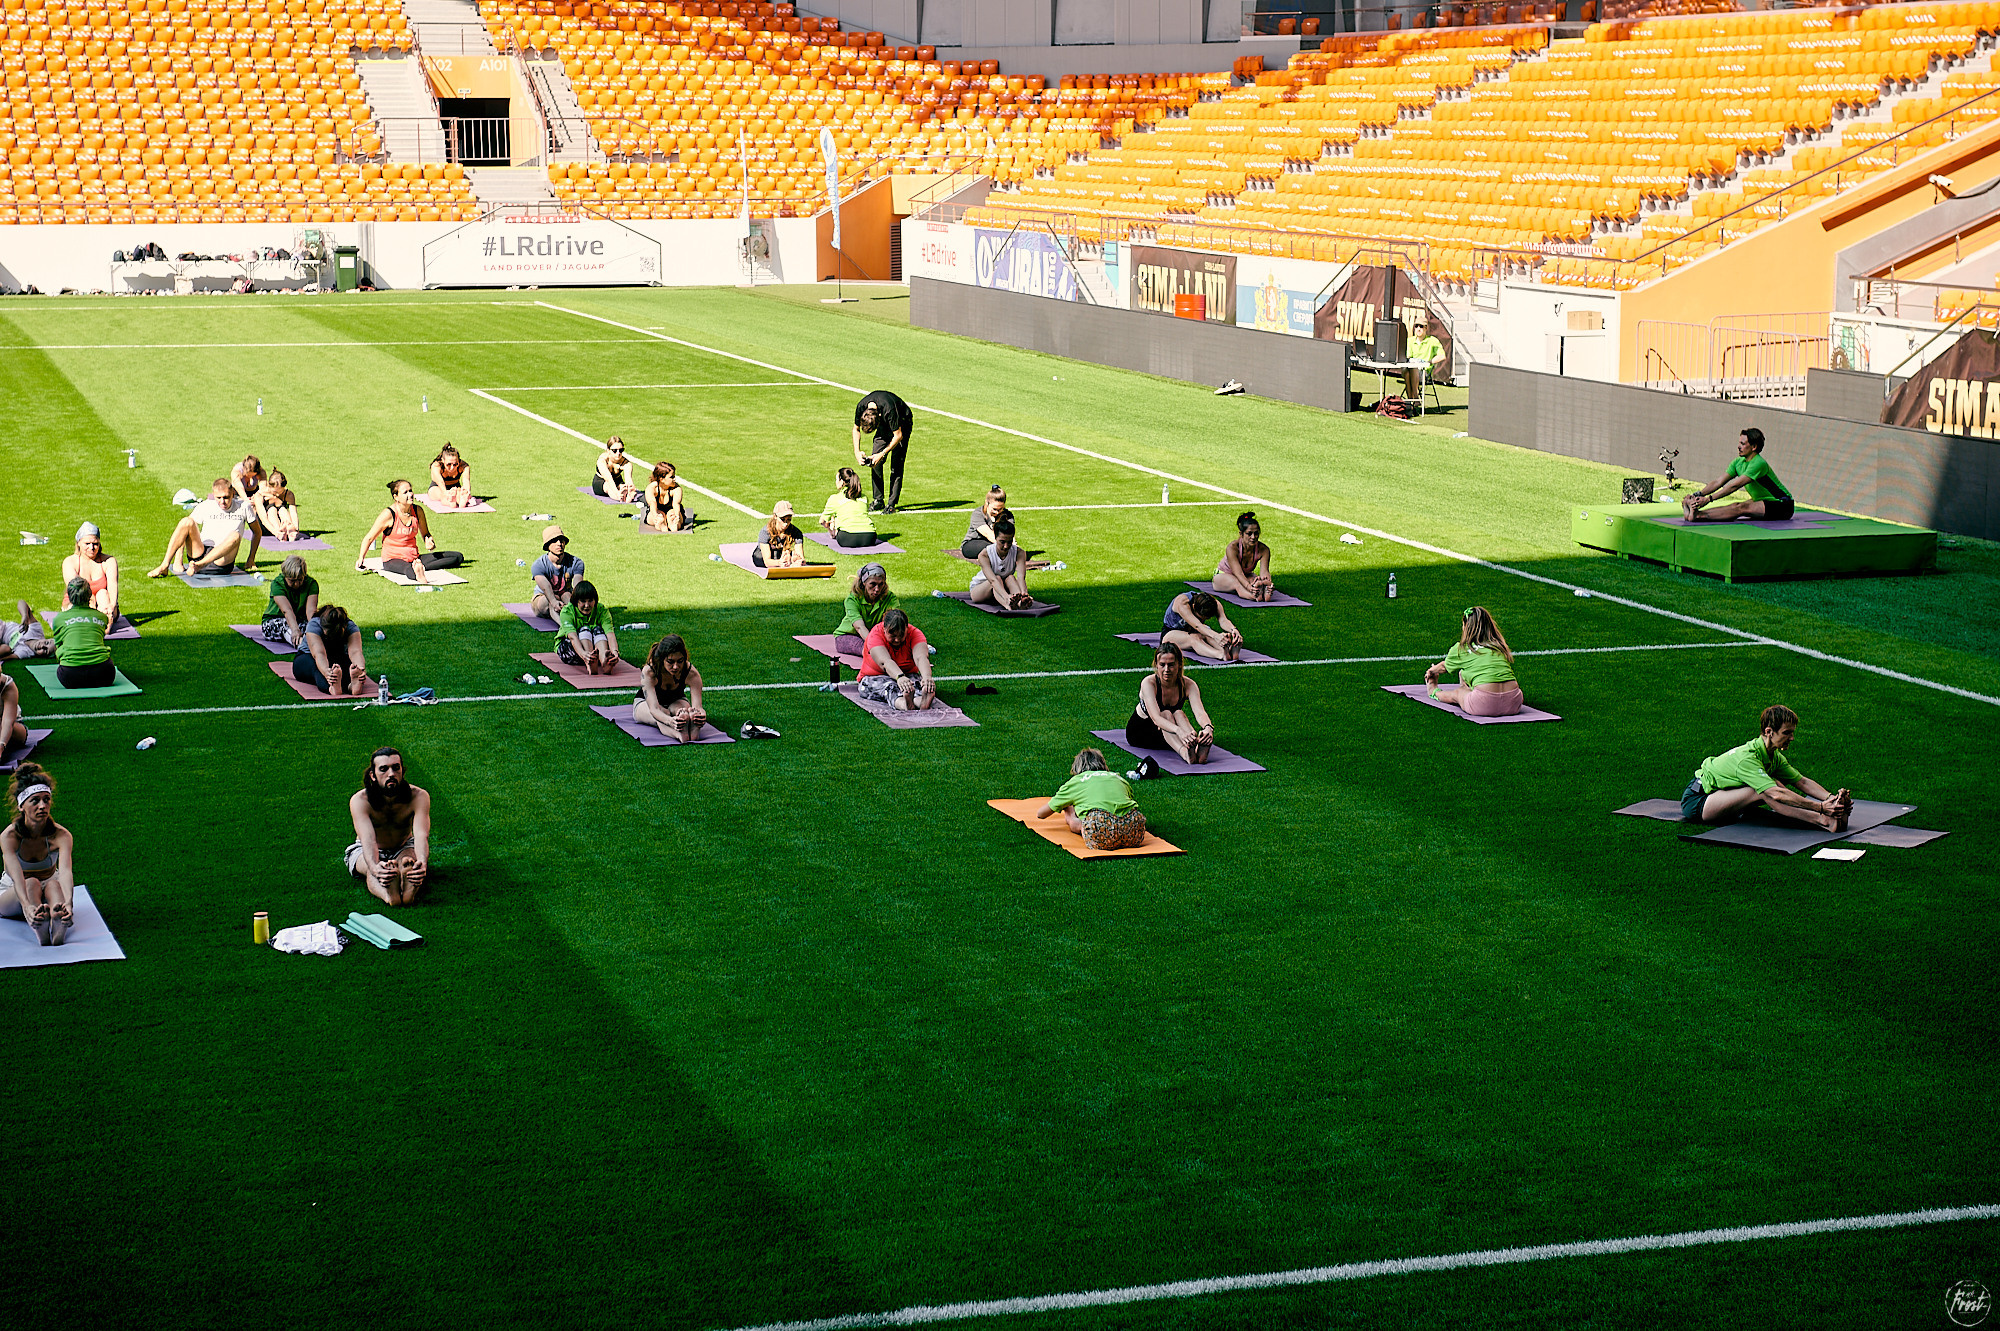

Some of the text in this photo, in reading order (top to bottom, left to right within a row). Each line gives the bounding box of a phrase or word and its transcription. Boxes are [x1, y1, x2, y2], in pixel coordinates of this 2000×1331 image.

[479, 59, 507, 72] A101
[482, 235, 604, 257] #LRdrive
[921, 241, 957, 267] #LRdrive
[484, 264, 513, 272] LAND
[562, 263, 605, 271] JAGUAR
[65, 616, 90, 626] YOGA
